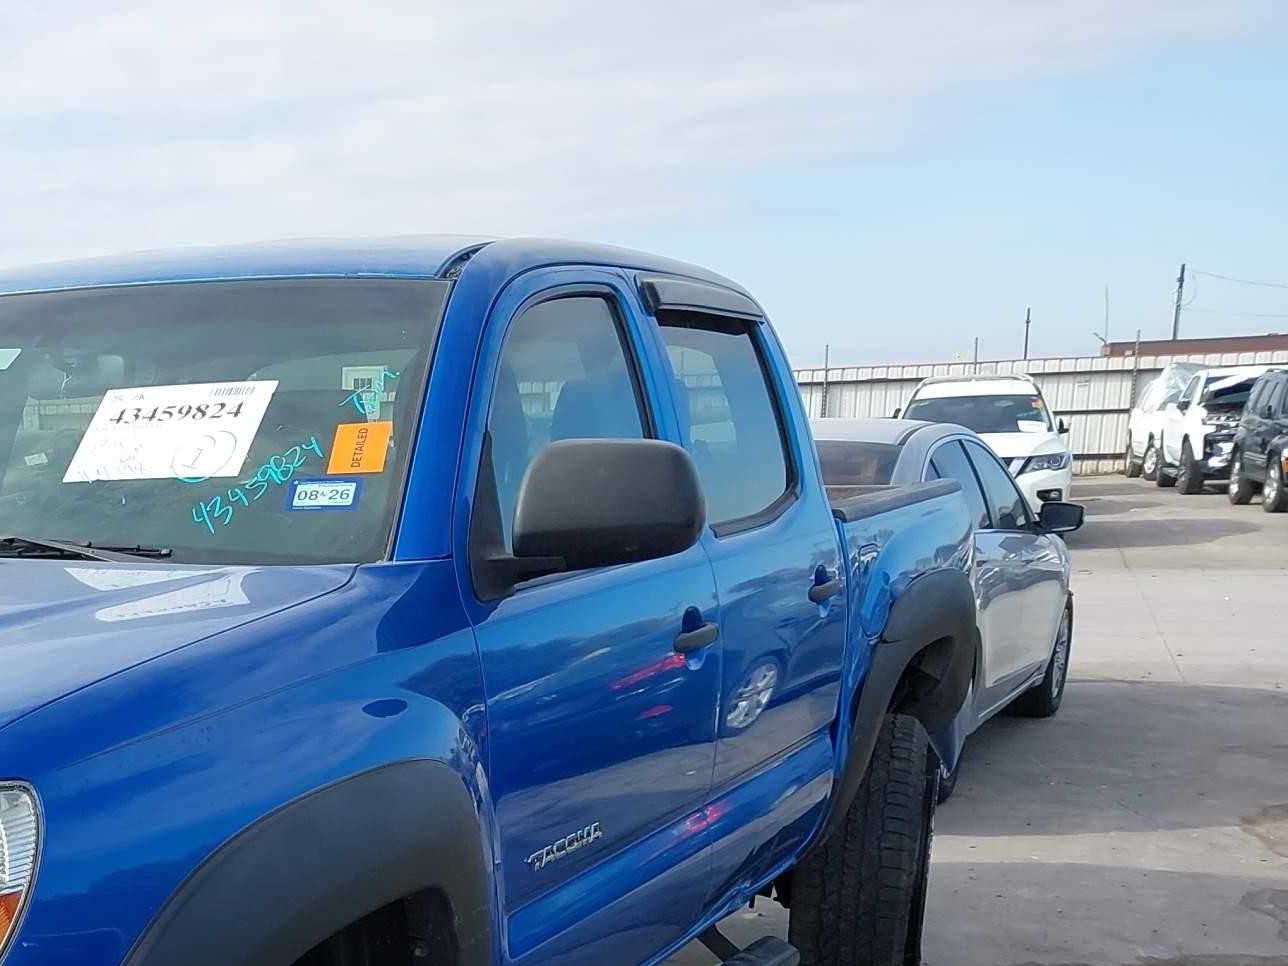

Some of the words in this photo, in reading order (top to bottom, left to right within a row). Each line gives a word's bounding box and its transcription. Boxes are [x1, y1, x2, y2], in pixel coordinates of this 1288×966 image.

[109, 401, 244, 424] 43459824
[350, 427, 369, 468] DETAILED
[192, 436, 323, 534] 43459824
[297, 489, 319, 501] 08
[328, 488, 351, 500] 26
